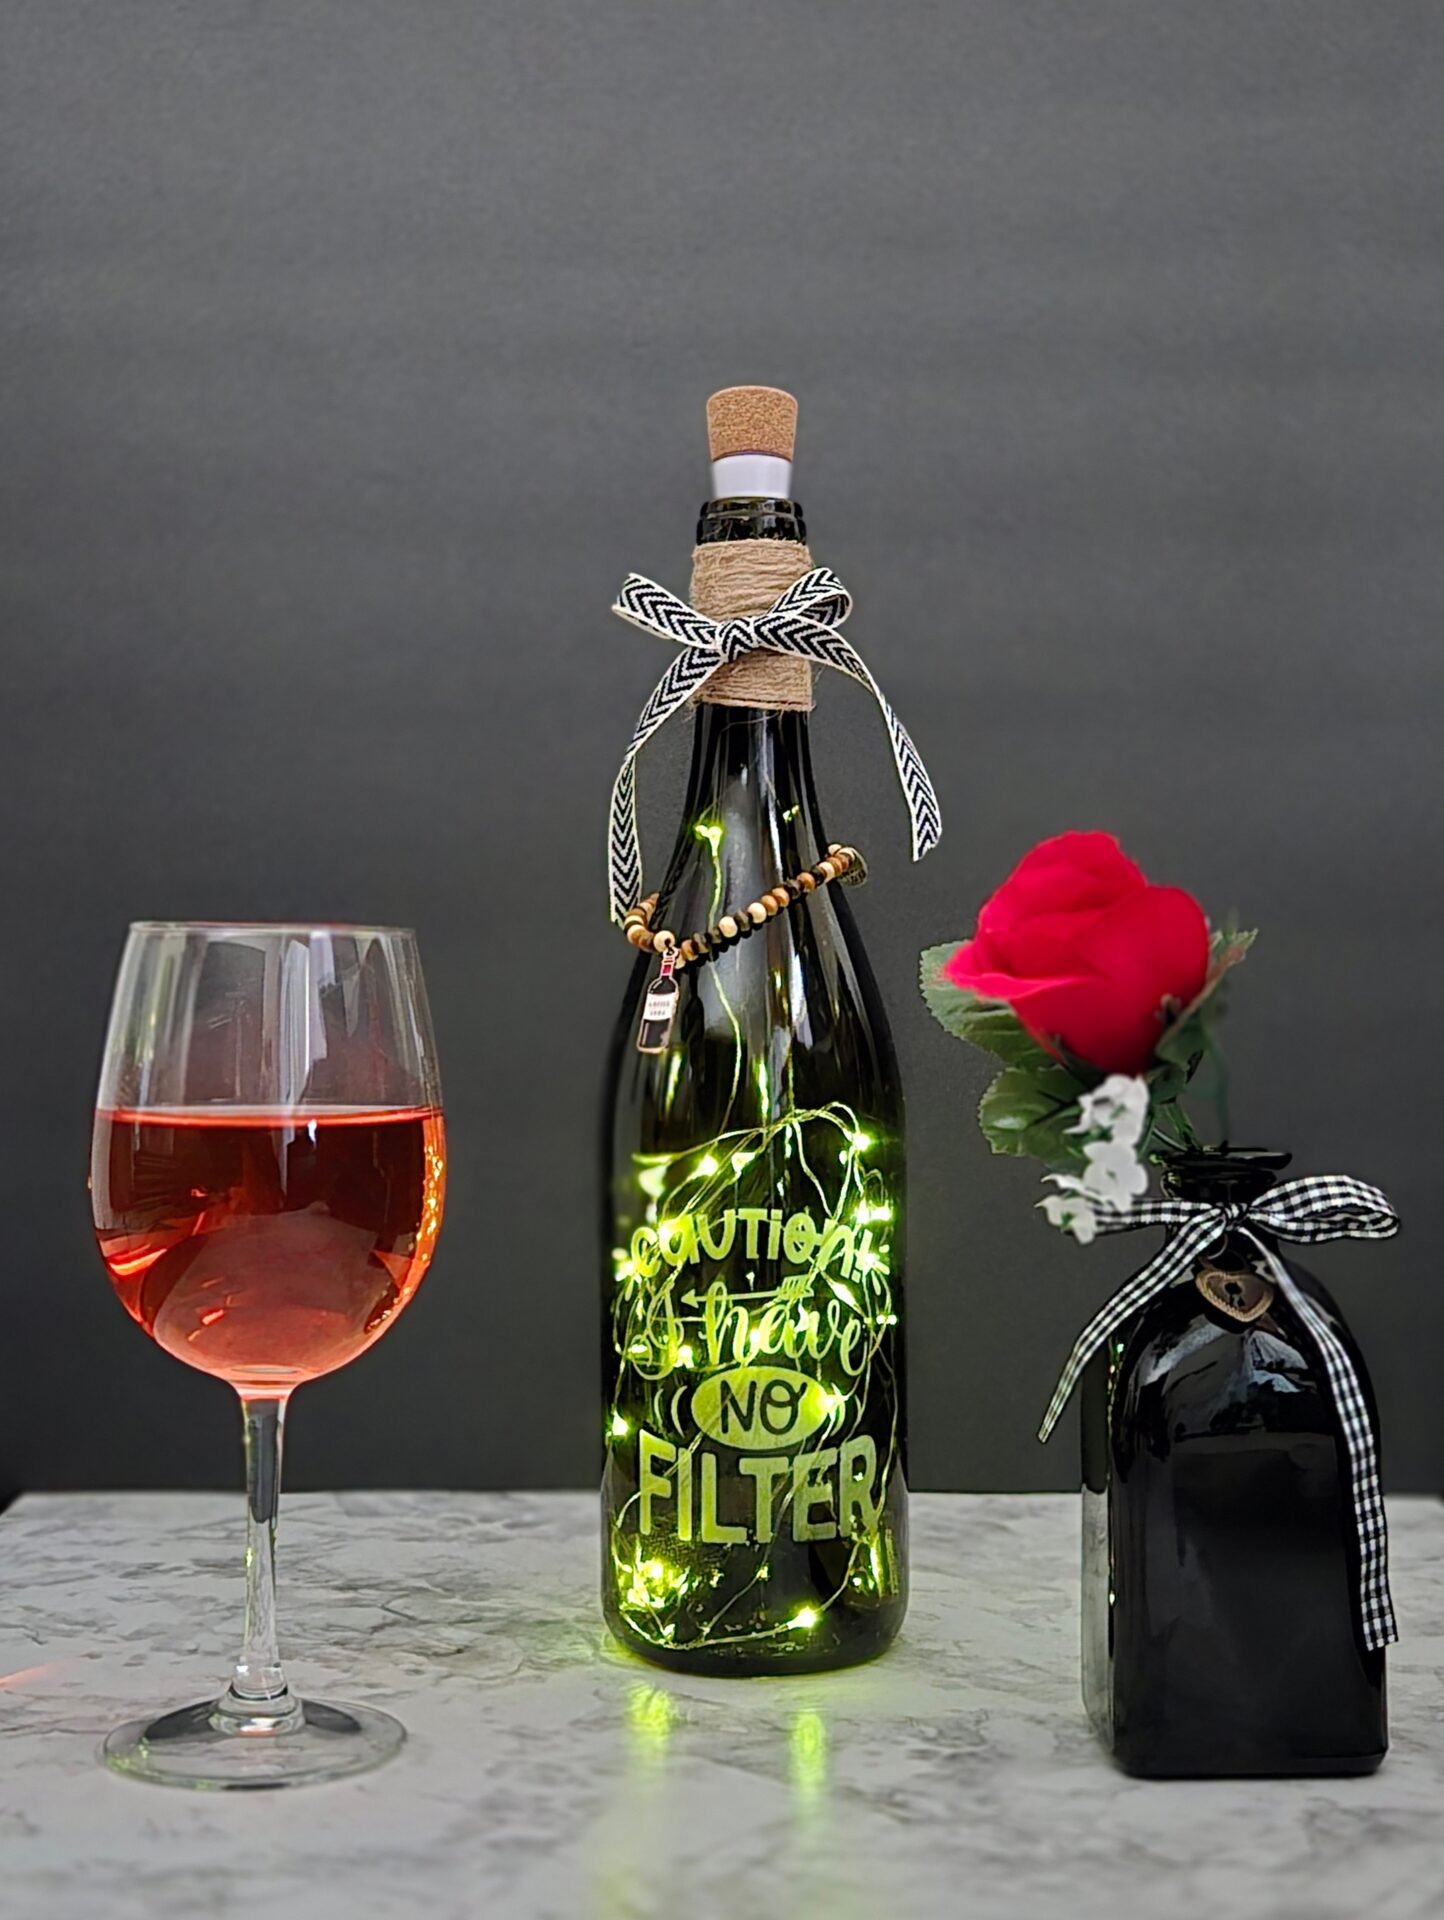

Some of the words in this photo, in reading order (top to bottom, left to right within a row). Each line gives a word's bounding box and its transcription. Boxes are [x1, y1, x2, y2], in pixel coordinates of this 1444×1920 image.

[698, 1280, 868, 1377] have
[719, 1378, 808, 1436] NO
[638, 1428, 880, 1544] FILTER
